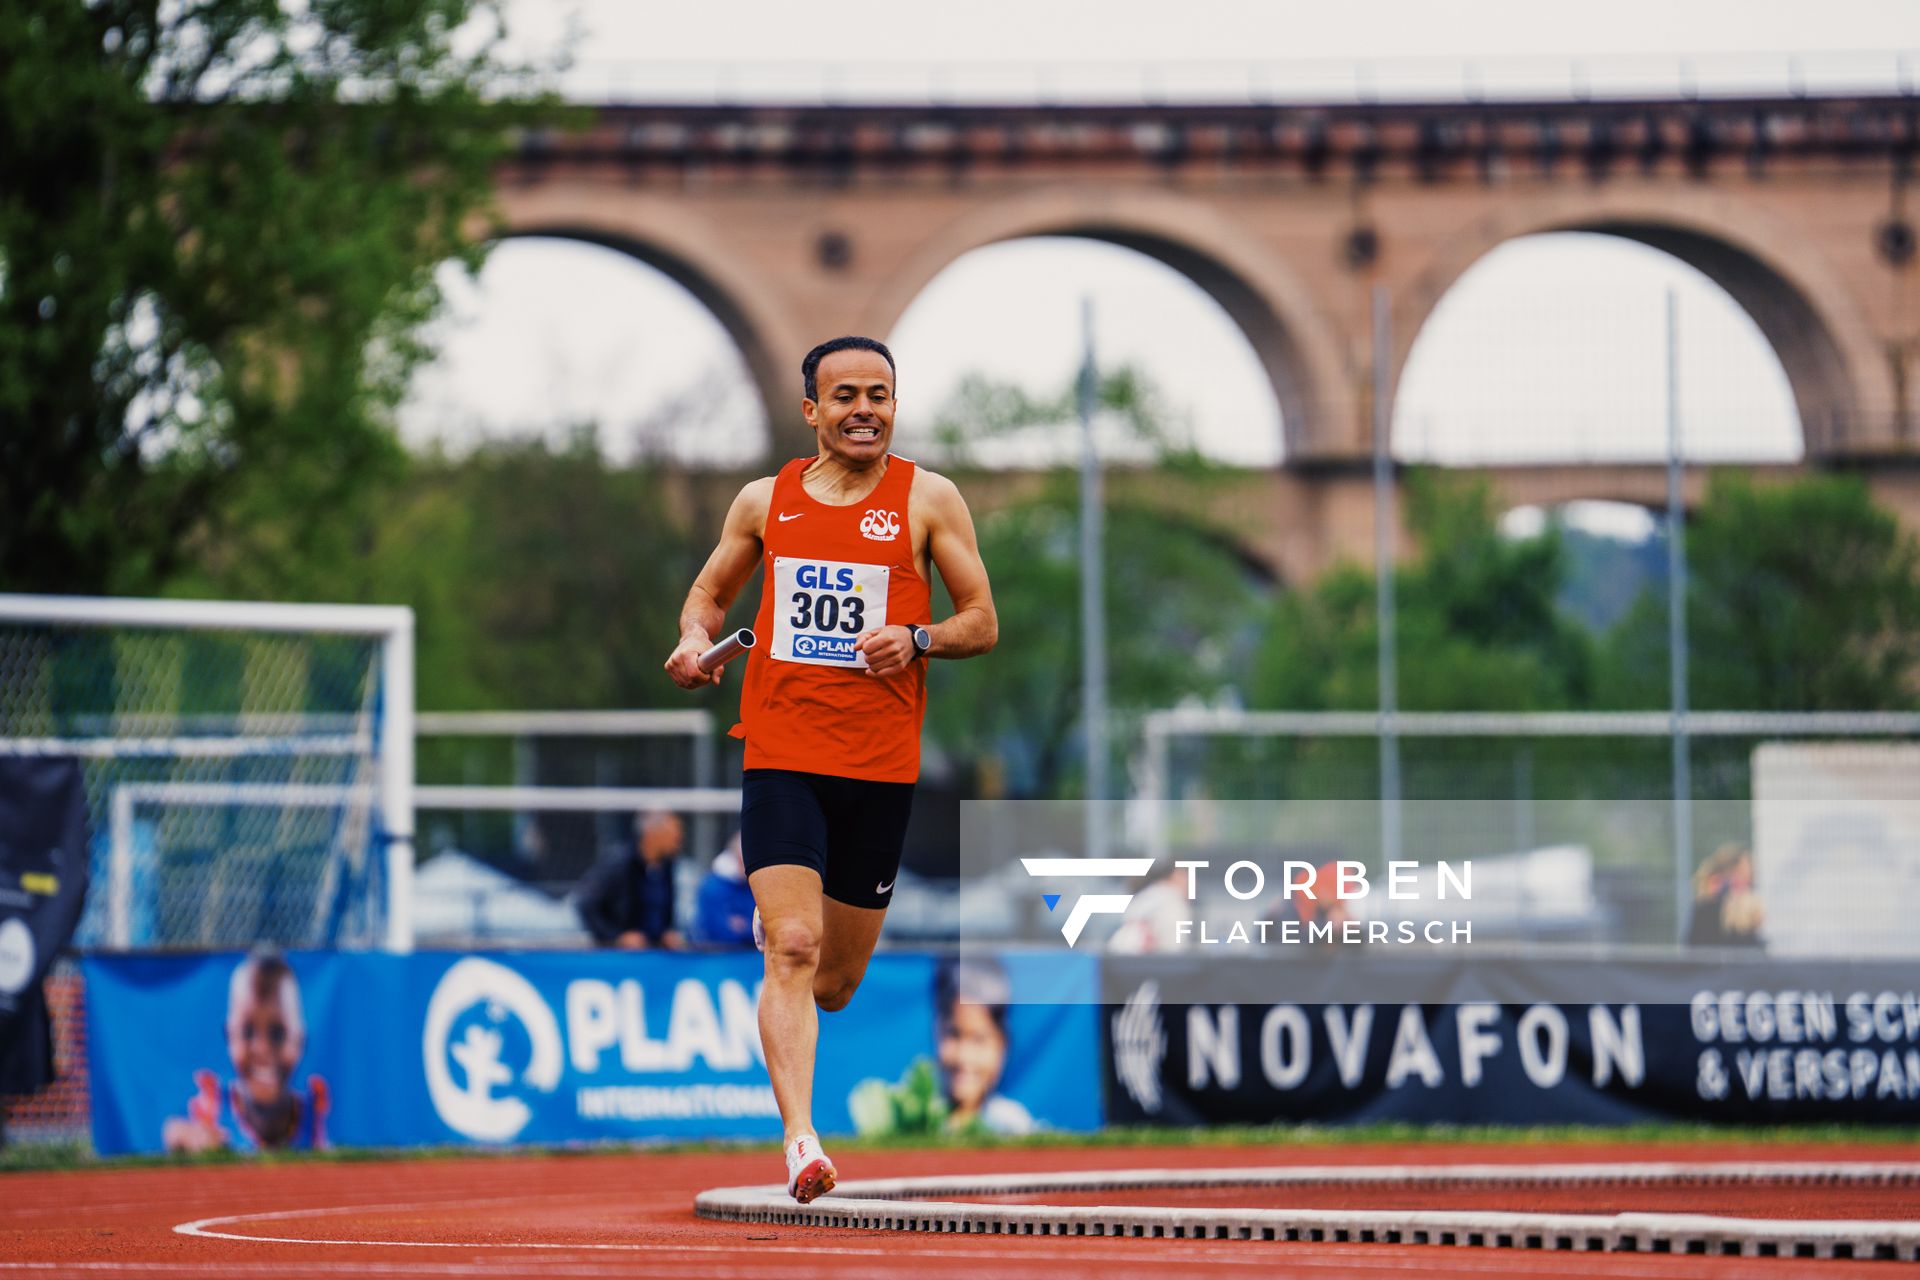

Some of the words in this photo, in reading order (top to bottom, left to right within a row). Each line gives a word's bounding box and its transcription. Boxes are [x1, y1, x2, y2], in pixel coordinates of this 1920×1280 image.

[790, 592, 864, 634] 303
[818, 640, 854, 653] PLAN
[1690, 989, 1837, 1042] GEGEN
[1187, 1003, 1645, 1090] NOVAFON
[1696, 1047, 1729, 1100] &
